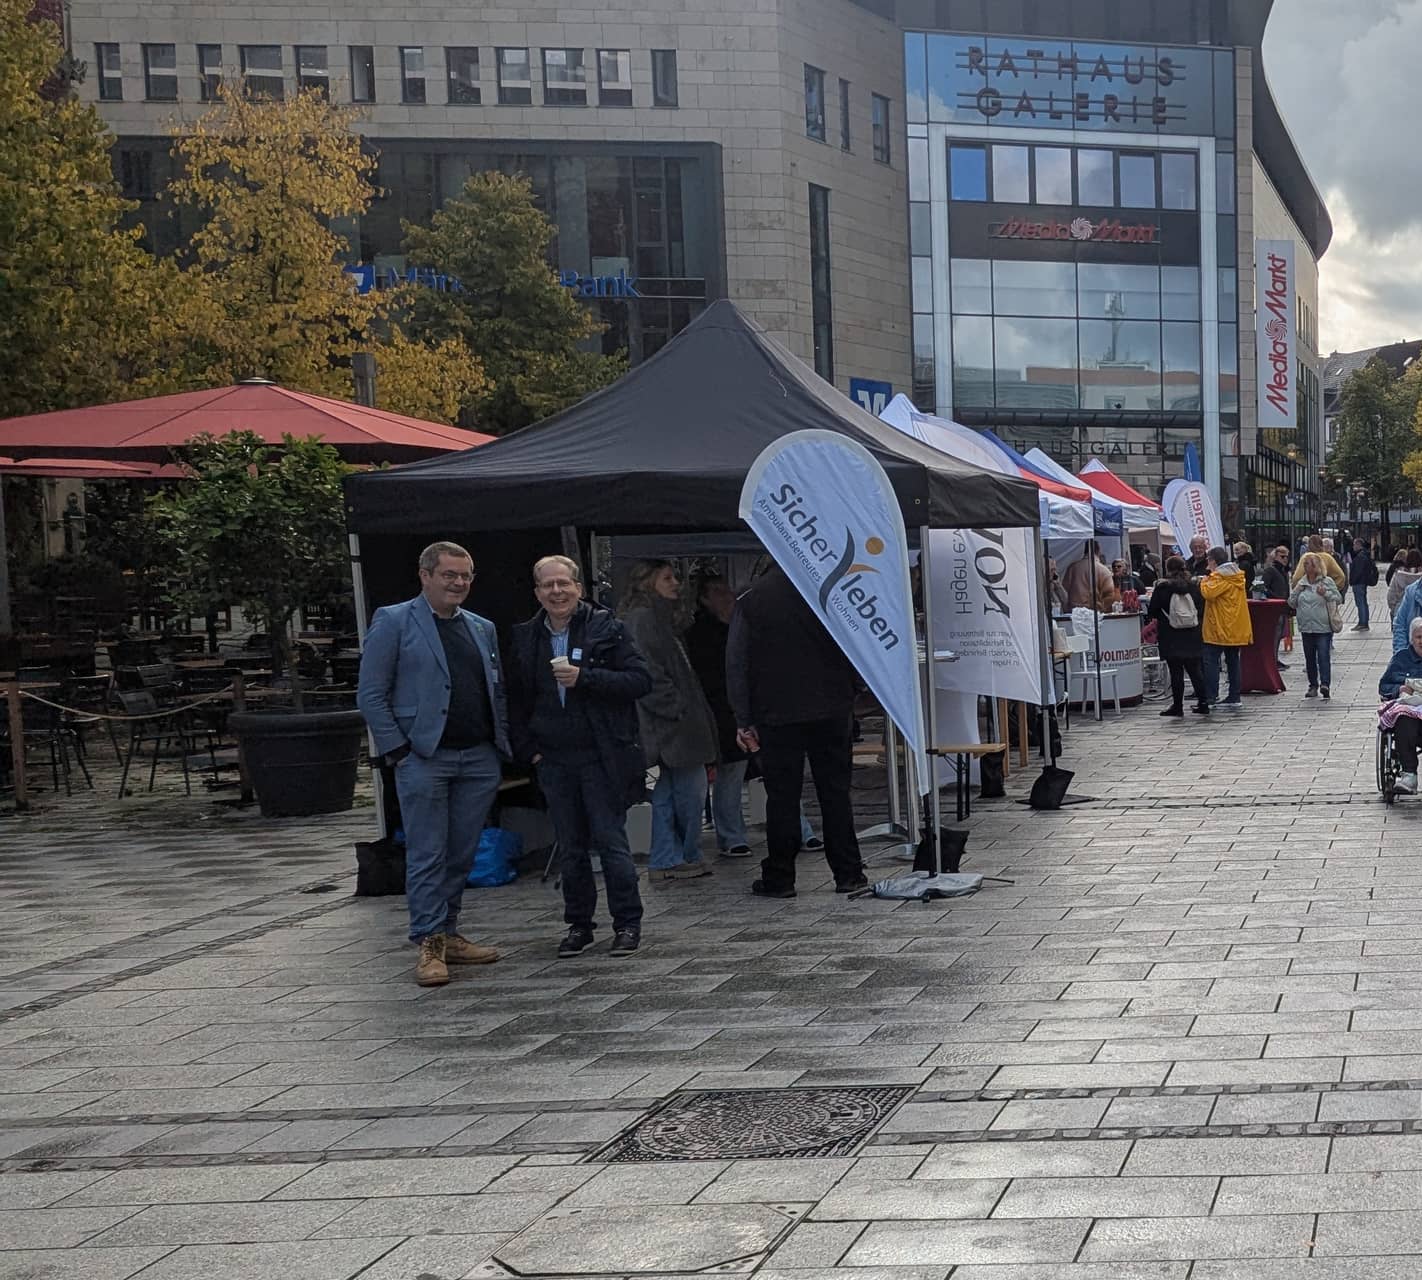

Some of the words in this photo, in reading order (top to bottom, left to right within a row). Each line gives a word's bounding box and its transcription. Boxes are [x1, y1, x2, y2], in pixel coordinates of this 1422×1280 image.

[967, 46, 1174, 86] RATHAUS
[976, 87, 1167, 125] GALERIE
[560, 267, 641, 297] Bank
[1090, 440, 1178, 456] GALERI
[757, 498, 792, 542] Ambulant
[788, 540, 823, 583] Betreutes
[831, 593, 860, 633] Wohnen
[769, 483, 838, 563] Sicher
[840, 574, 899, 651] leben
